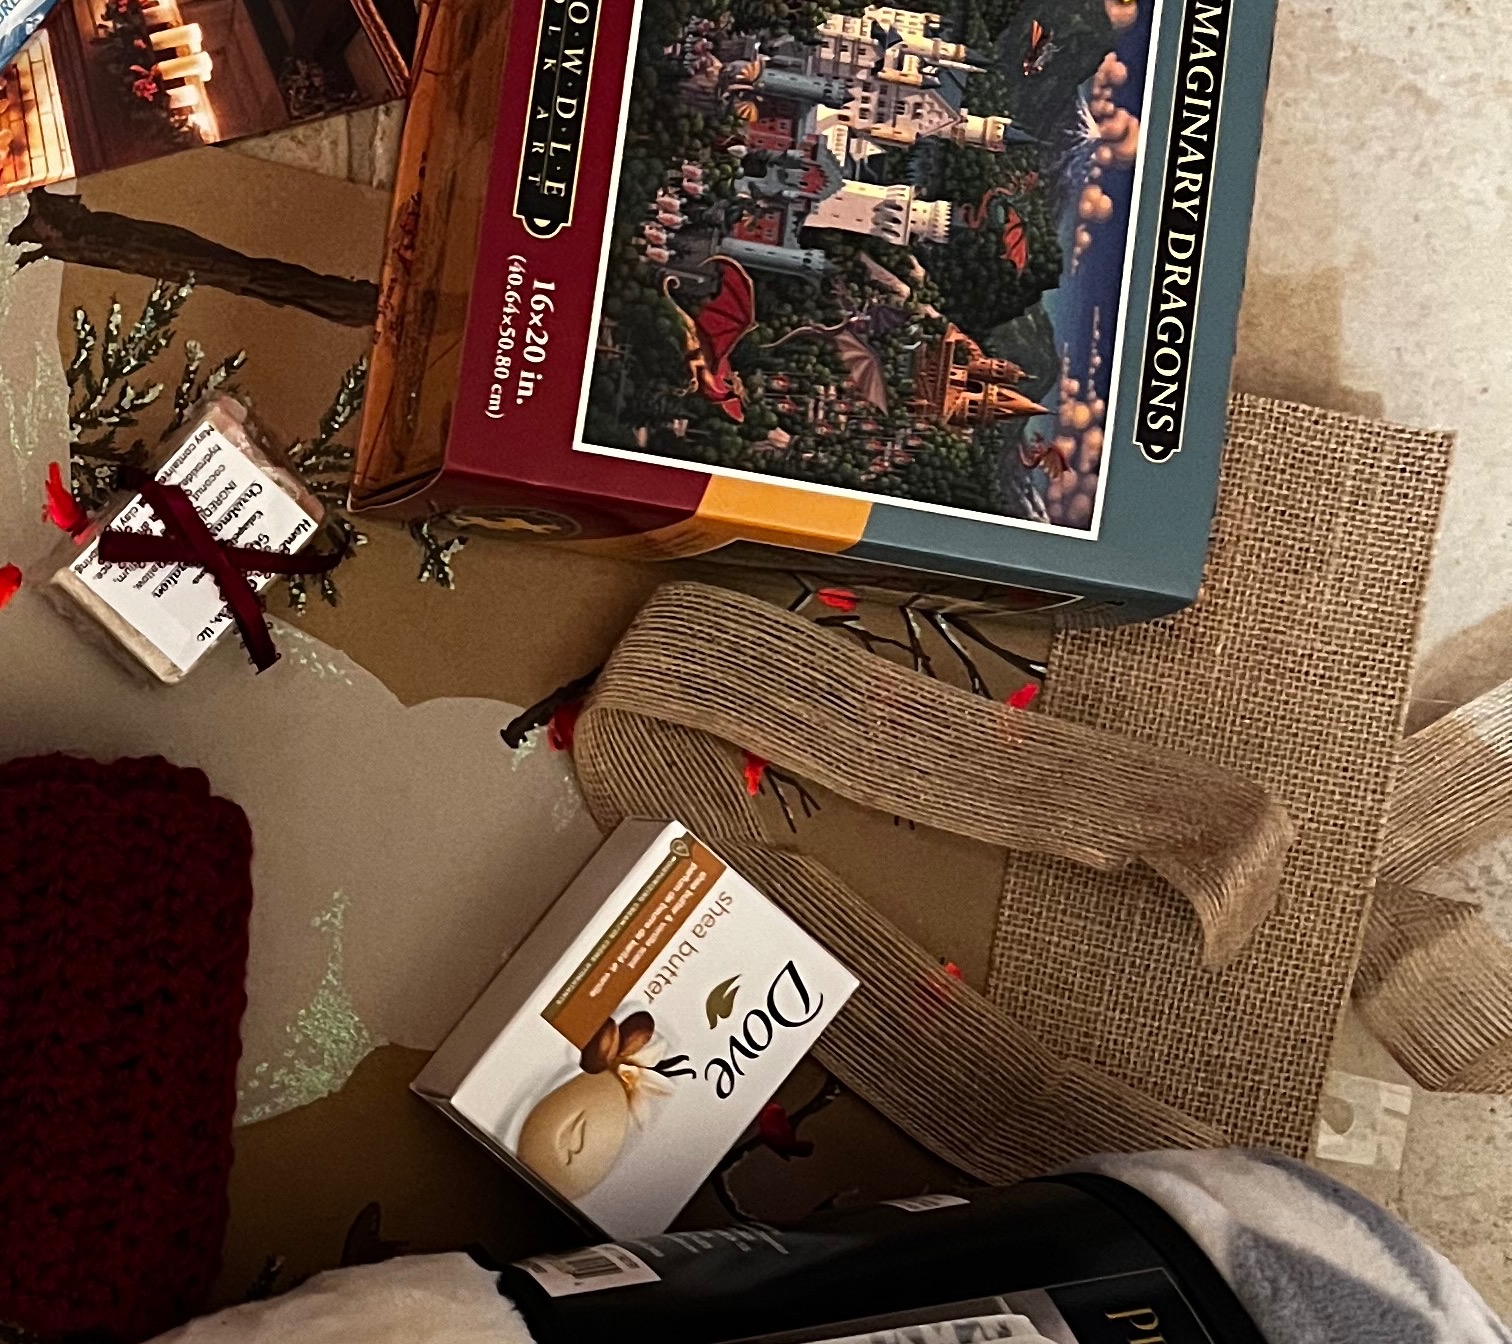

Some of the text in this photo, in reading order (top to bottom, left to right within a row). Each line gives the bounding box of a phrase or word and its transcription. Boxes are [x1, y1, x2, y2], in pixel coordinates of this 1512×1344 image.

[1146, 223, 1199, 431] DRAGONS
[485, 376, 506, 419] cm)
[517, 374, 535, 406] in.
[165, 424, 215, 476] May contain
[189, 464, 225, 501] coconut
[643, 891, 732, 1003] shea butter
[704, 960, 824, 1099] Dove
